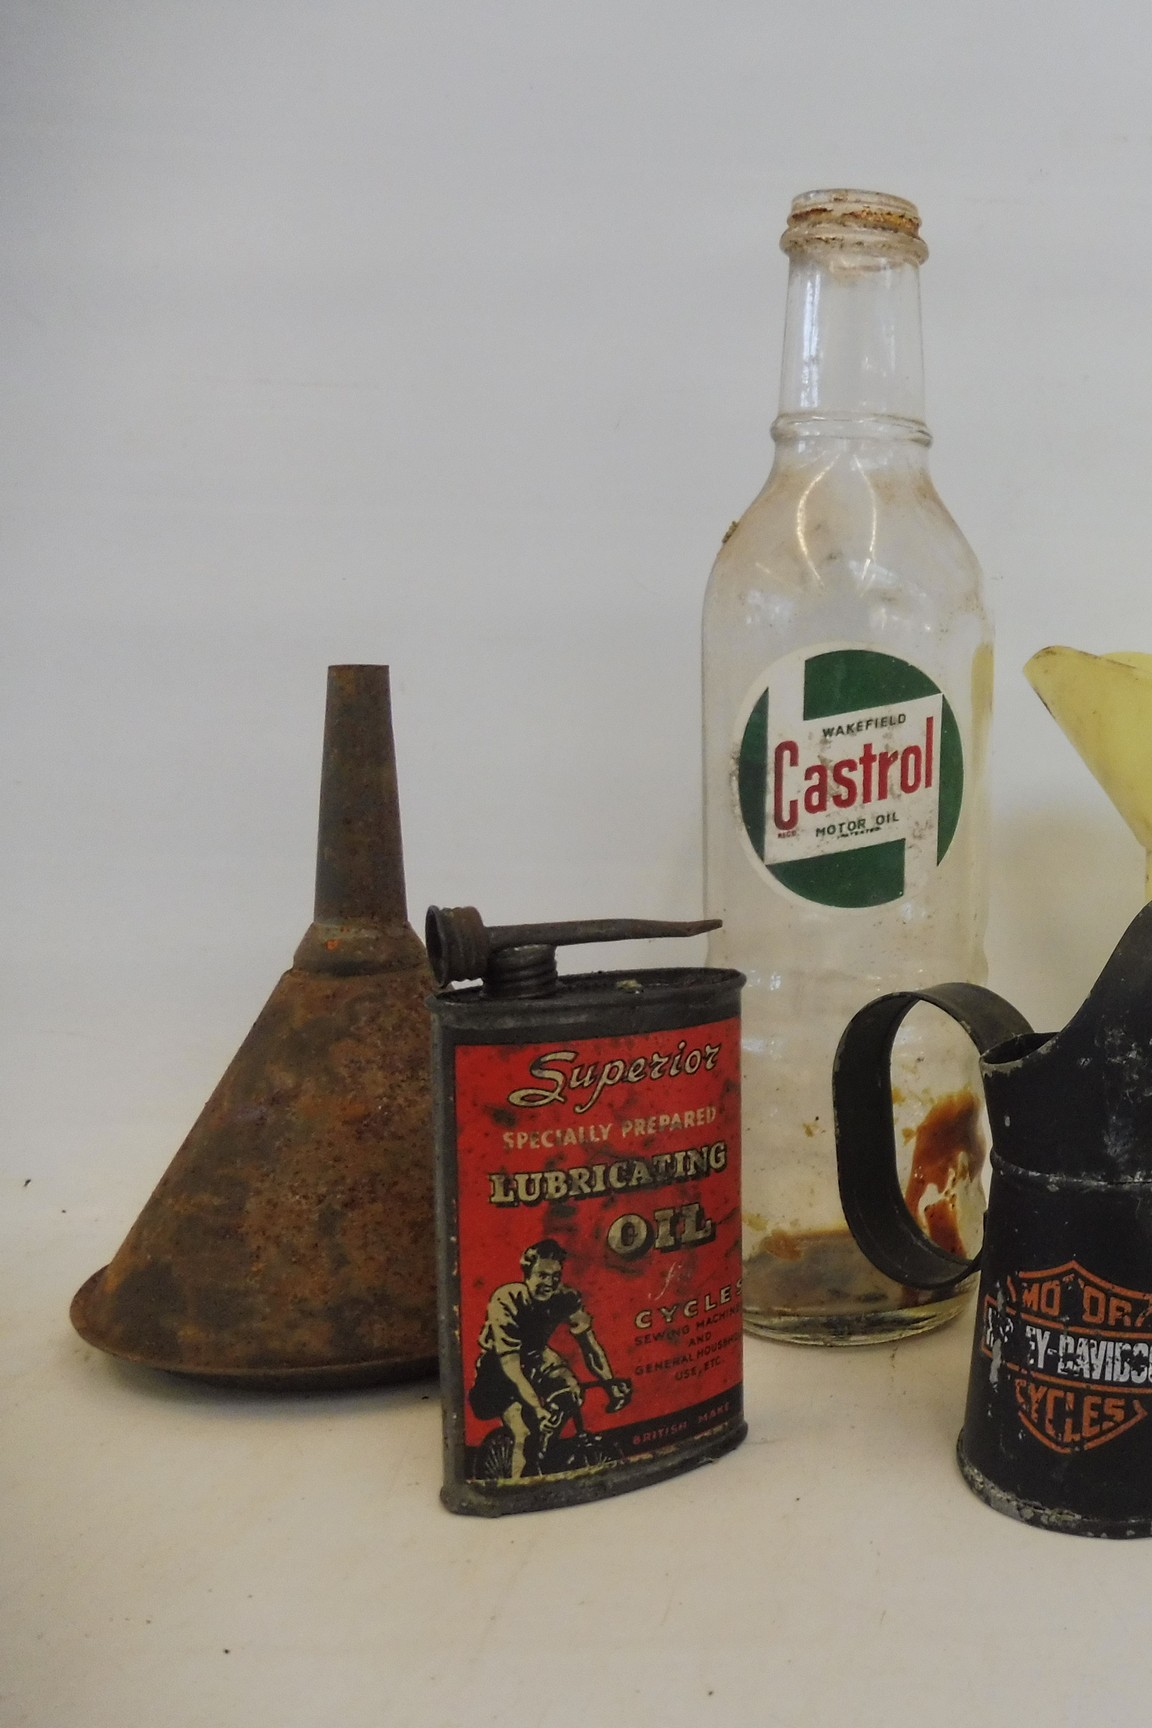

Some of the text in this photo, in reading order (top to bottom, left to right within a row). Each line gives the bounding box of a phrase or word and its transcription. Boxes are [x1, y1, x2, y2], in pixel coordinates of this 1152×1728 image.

[823, 714, 906, 738] WAKEFIELD
[773, 716, 934, 831] Castrol
[816, 812, 900, 837] MOTOR OIL
[507, 1041, 722, 1114] Superior
[503, 1106, 717, 1150] SPECIALLY PREPARED
[488, 1142, 728, 1207] LUBRICATING
[607, 1202, 716, 1256] OIL
[1023, 1274, 1132, 1326] MOOR
[634, 1322, 690, 1346] SEWING
[688, 1332, 711, 1347] AND
[635, 1354, 693, 1376] GENERAL
[633, 1401, 731, 1445] BRITISH MAKE
[1014, 1378, 1126, 1443] CYCLES
